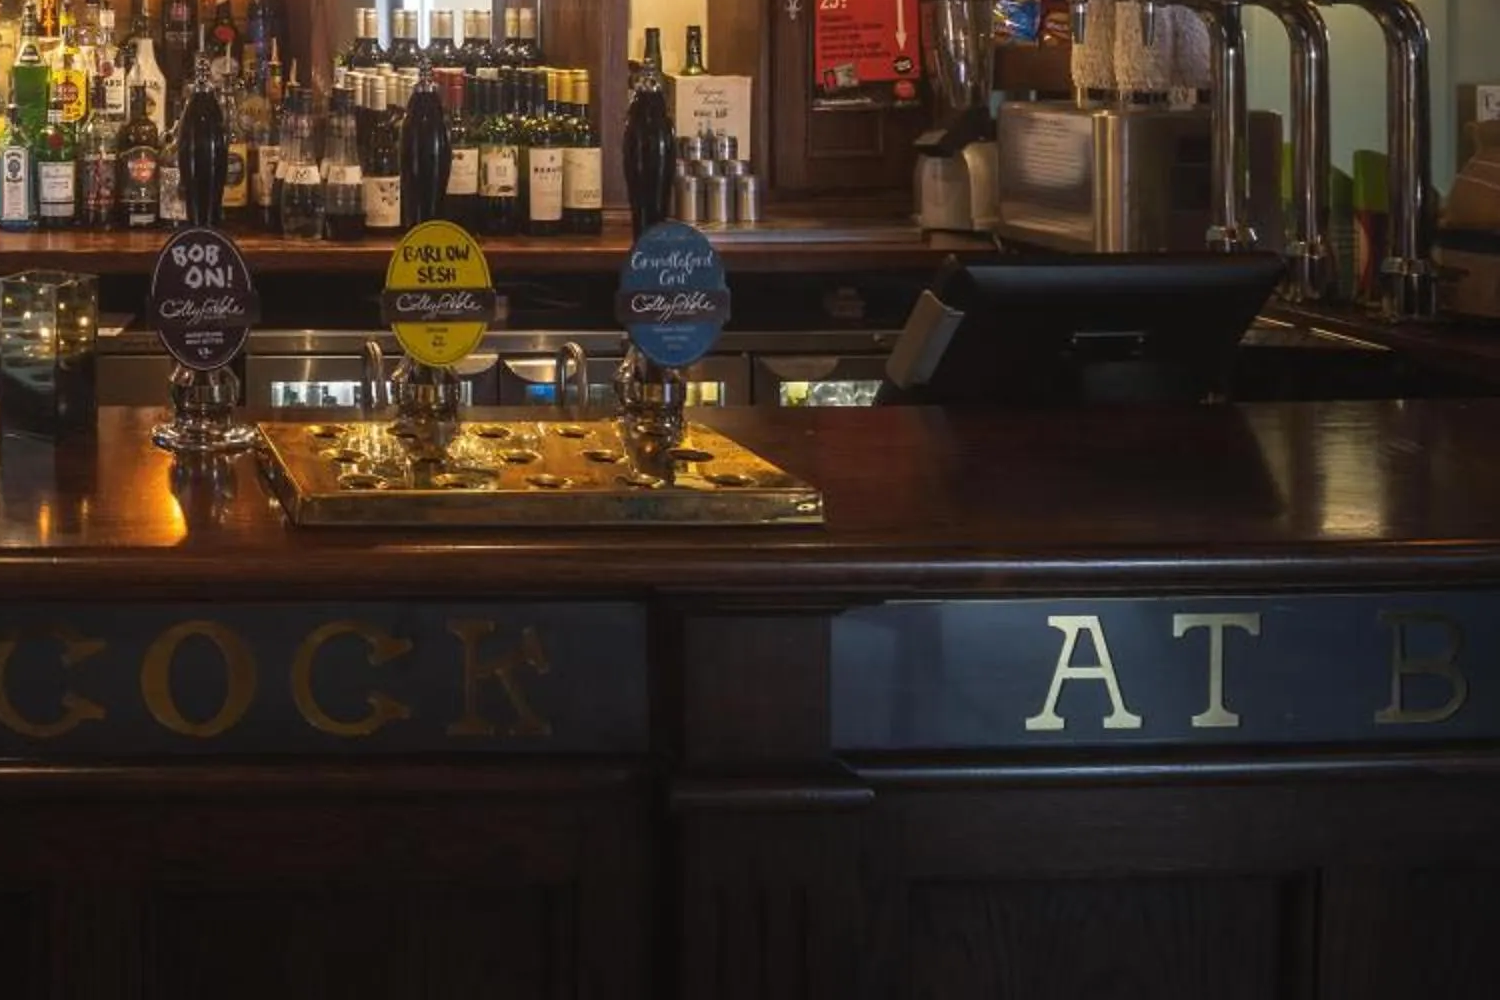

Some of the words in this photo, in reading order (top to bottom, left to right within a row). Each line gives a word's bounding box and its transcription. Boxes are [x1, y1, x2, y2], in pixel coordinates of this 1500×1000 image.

[171, 243, 221, 268] BOB
[403, 243, 470, 263] BARLOW
[184, 265, 234, 289] ON!
[417, 265, 457, 284] SESH
[1025, 612, 1261, 731] AT
